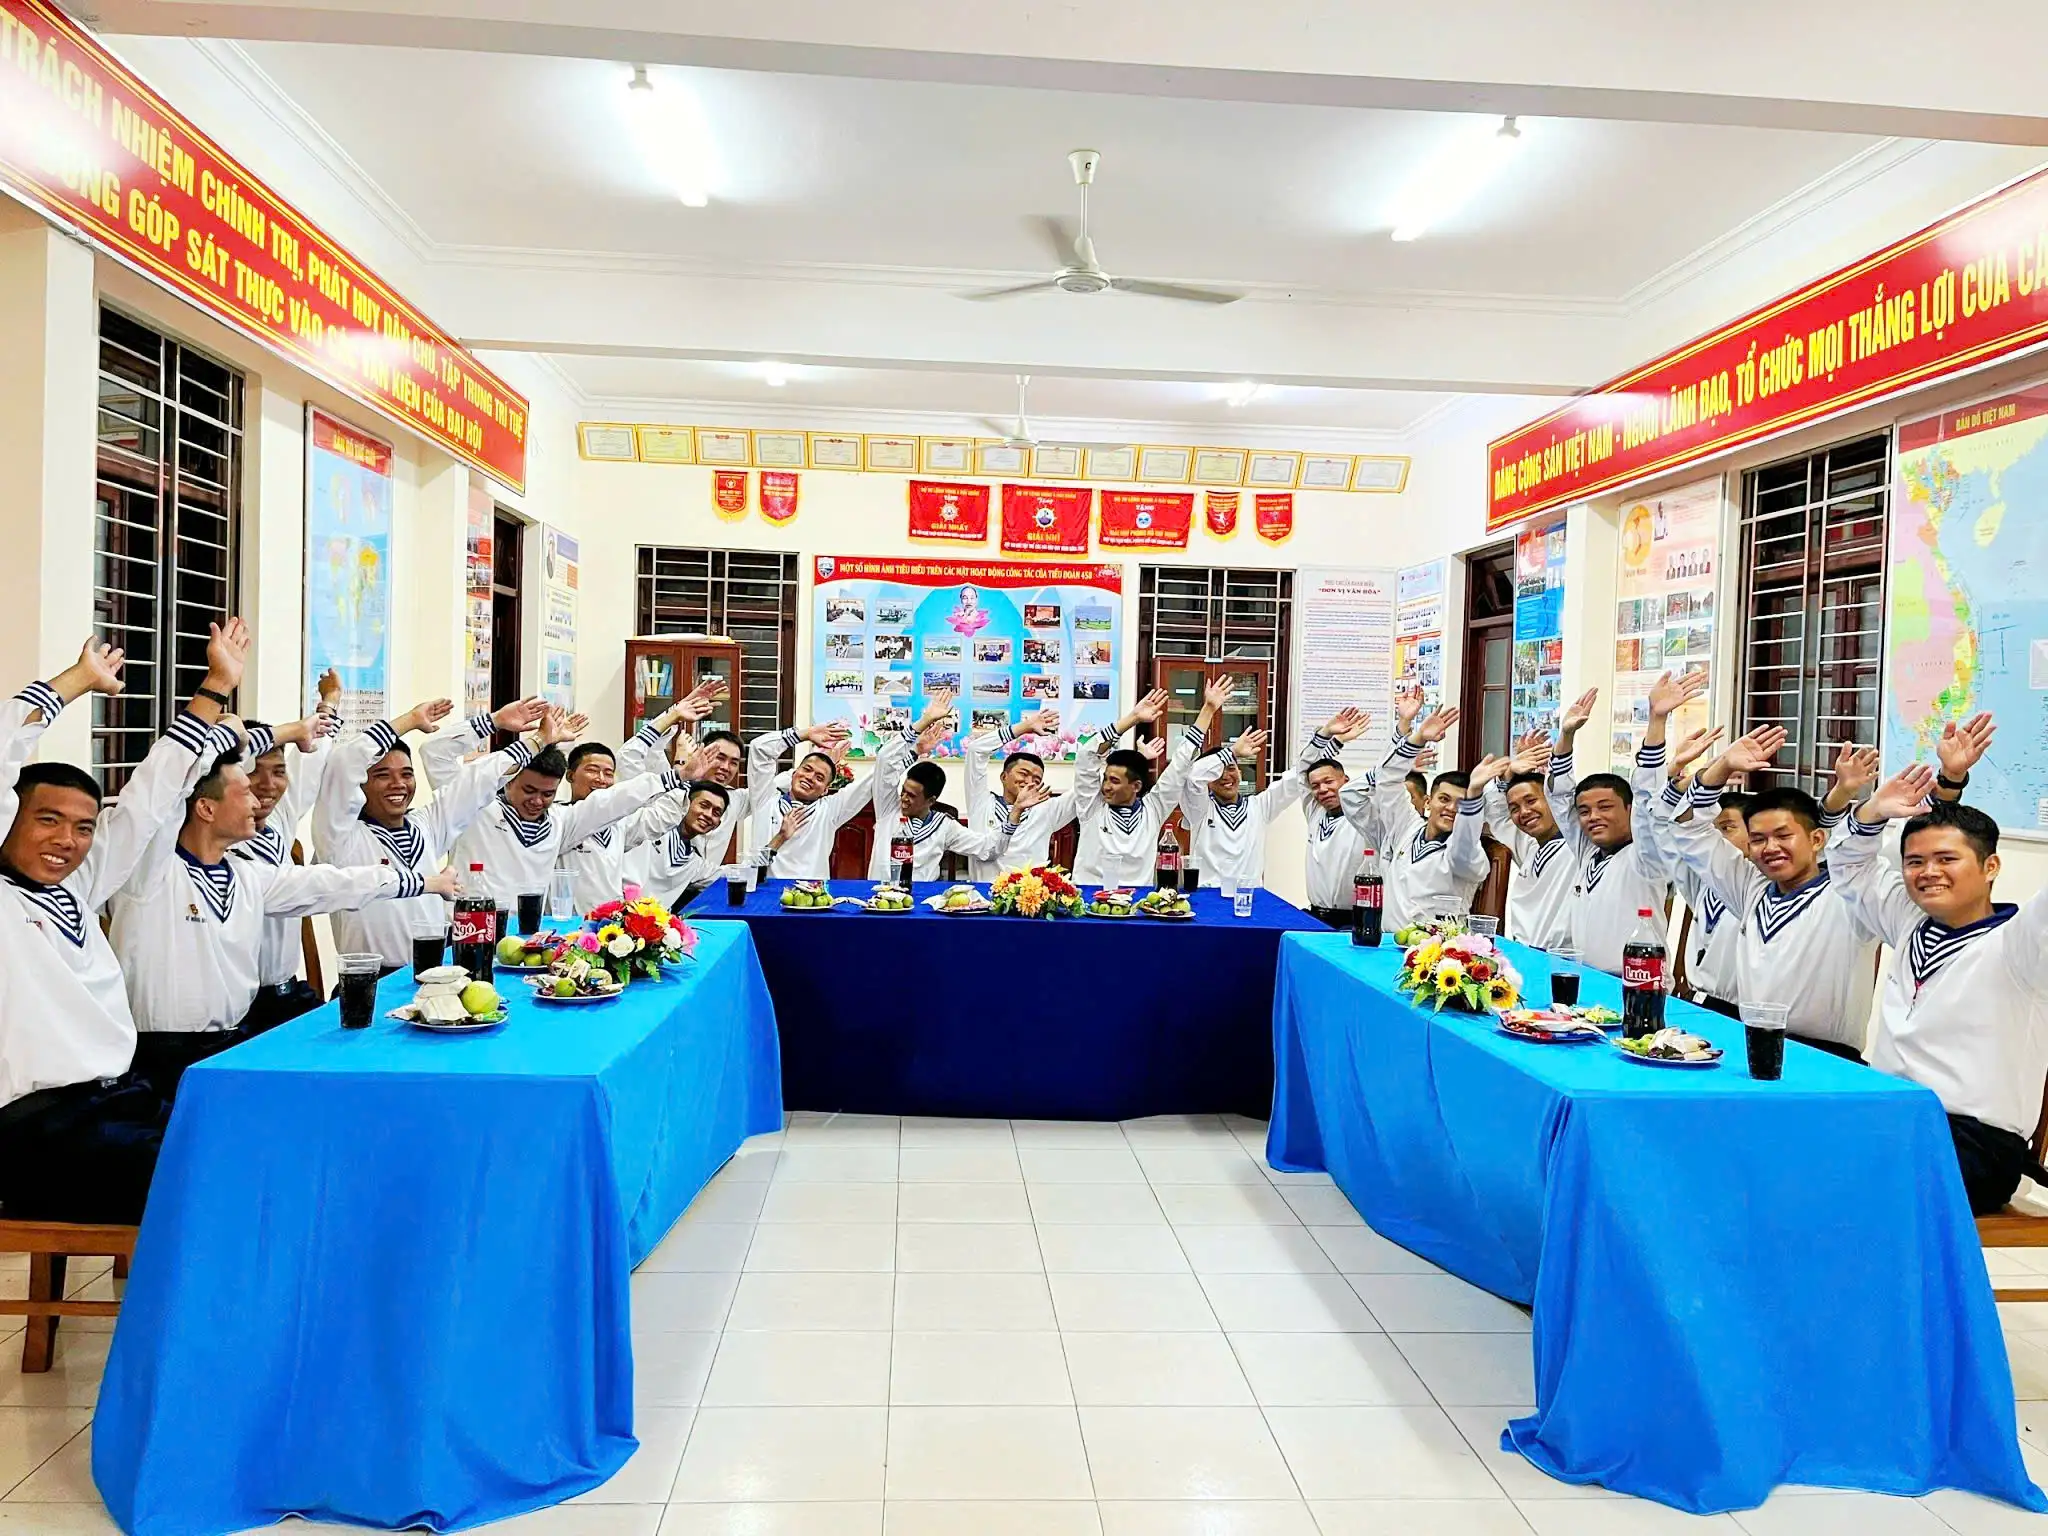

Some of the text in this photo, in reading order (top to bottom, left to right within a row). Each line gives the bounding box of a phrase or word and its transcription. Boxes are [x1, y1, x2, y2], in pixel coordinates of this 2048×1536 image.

[112, 96, 195, 198] NHIỆM
[201, 169, 266, 249] CHÍNH
[308, 251, 350, 311] PHÁT
[352, 286, 381, 336] HUY
[383, 310, 410, 357] DÂN
[441, 356, 461, 394] TẬP
[462, 372, 493, 418] TRUNG
[494, 397, 508, 429] TRÍ
[128, 188, 180, 252] GÓP
[186, 228, 230, 289] SÁT
[234, 263, 285, 324] THỰC
[289, 296, 323, 349] VÀO
[391, 367, 420, 414] KIỆN
[423, 387, 445, 429] CỦA
[447, 407, 465, 442] ĐẠI
[466, 419, 482, 454] HỘI
[1495, 457, 1516, 501] ĐẢNG
[1518, 449, 1542, 496] CỘNG
[1544, 434, 1563, 480] SẢN
[1565, 428, 1587, 477] VIỆT
[1588, 419, 1613, 465] NAM
[1662, 383, 1697, 436] LÃNH
[1736, 340, 1757, 407] TỔ
[1759, 333, 1804, 398] CHỨC
[1808, 320, 1844, 382] MỌI
[1849, 283, 1915, 362] THẮNG
[1920, 269, 1955, 341] LỢI
[1998, 403, 2016, 419] NAM
[855, 560, 864, 573] SỐ
